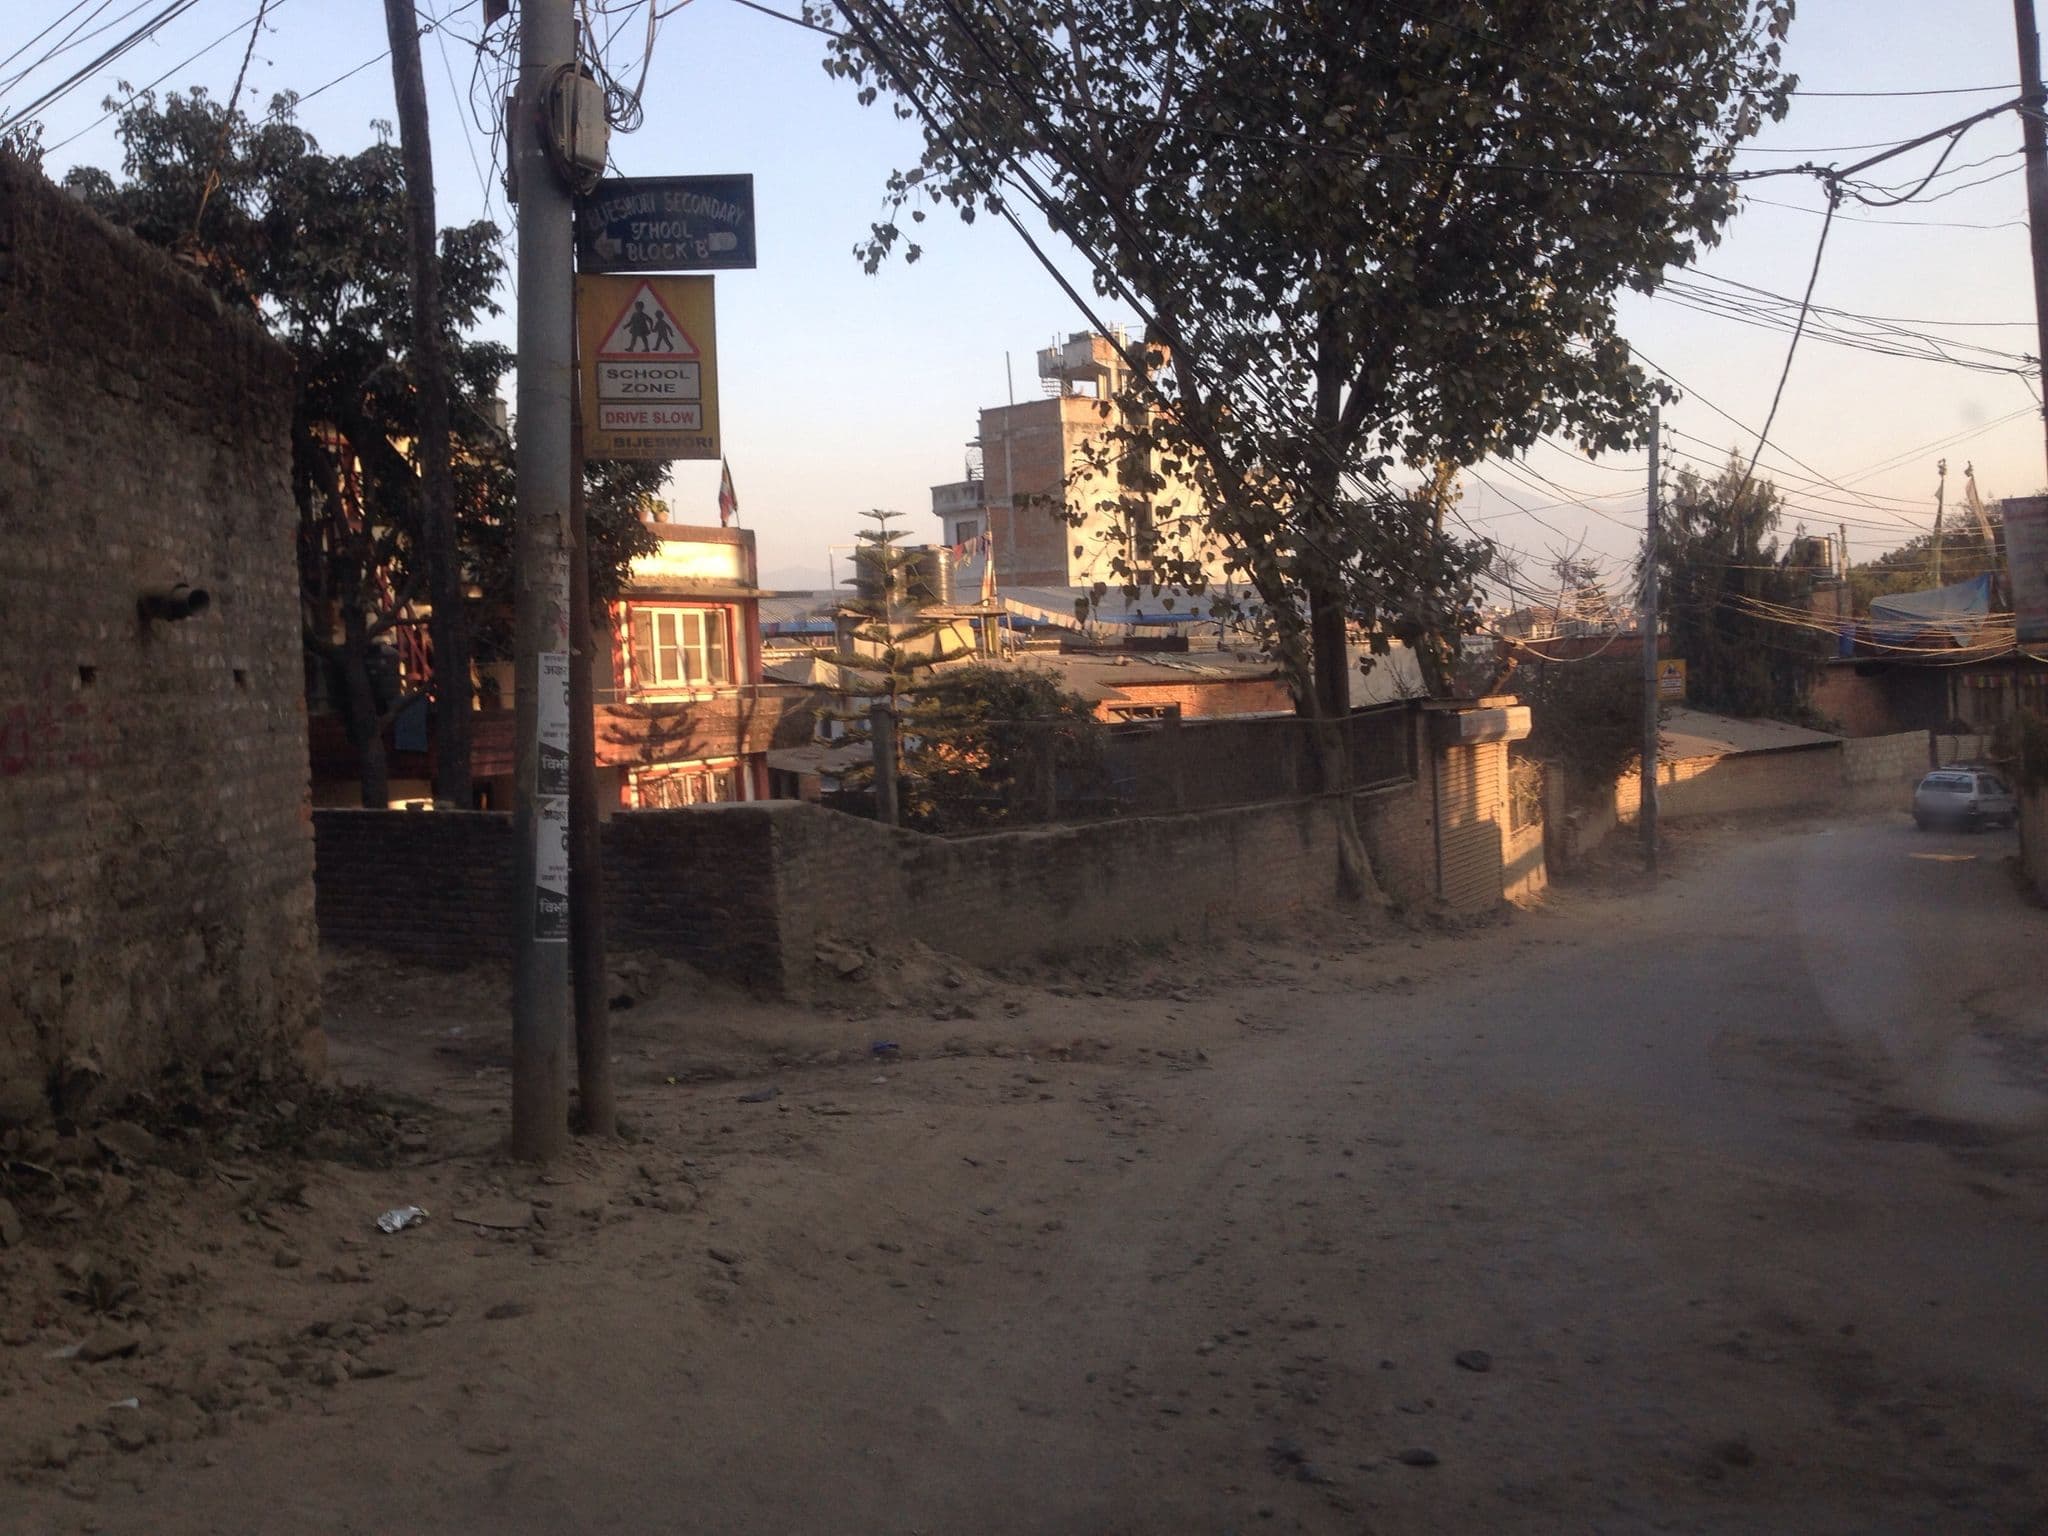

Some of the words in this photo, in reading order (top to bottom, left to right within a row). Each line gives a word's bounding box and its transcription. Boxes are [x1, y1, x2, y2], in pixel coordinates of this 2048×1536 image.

[664, 192, 745, 226] SECONDARY
[630, 221, 694, 240] SCHOOL
[626, 242, 687, 262] BLOCK
[606, 369, 691, 380] SCHOOL
[621, 383, 676, 394] ZONE
[605, 412, 648, 424] DRIVE
[653, 411, 694, 424] SLOW
[614, 437, 712, 448] BIJESWORI
